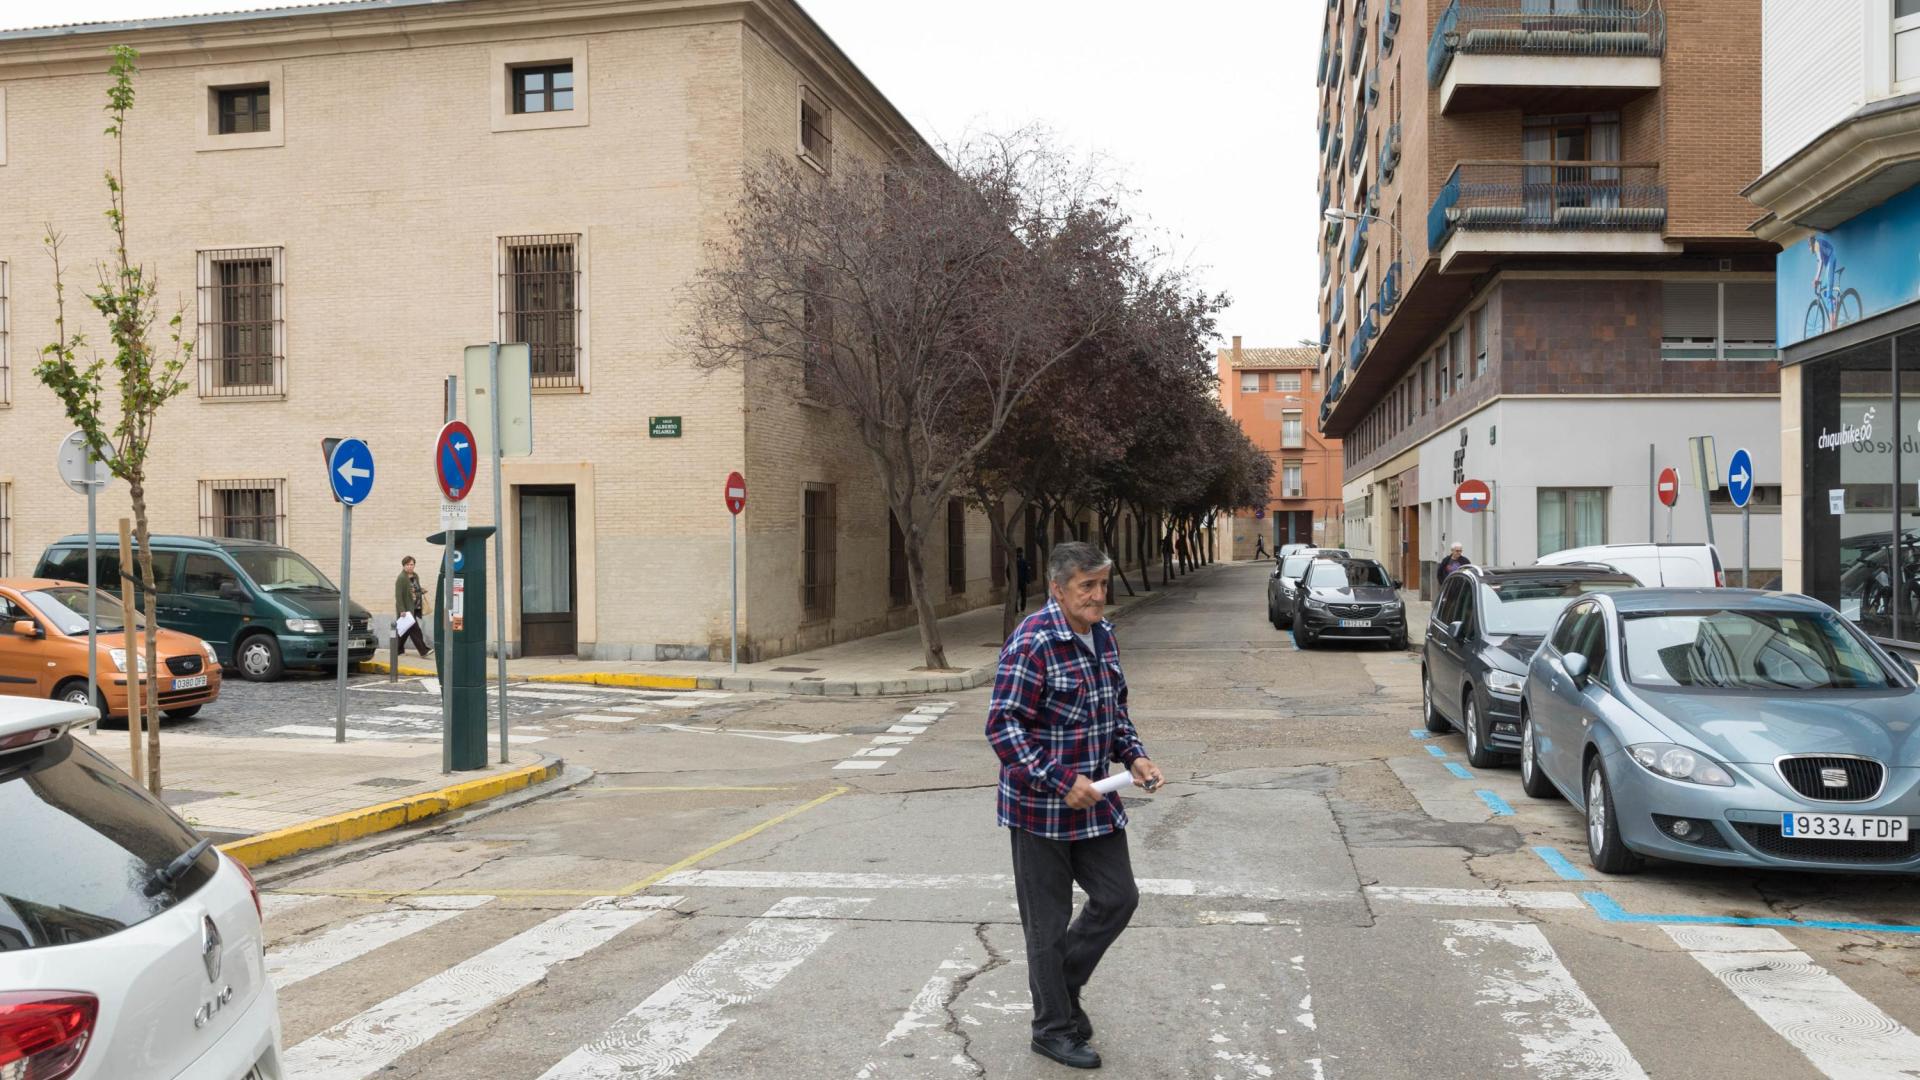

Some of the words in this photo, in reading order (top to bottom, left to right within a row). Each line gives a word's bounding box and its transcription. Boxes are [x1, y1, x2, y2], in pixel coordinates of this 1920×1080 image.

[177, 679, 193, 688] 0380
[1797, 816, 1855, 837] 9334
[1862, 819, 1902, 838] FDP
[194, 985, 232, 1028] CLIO
